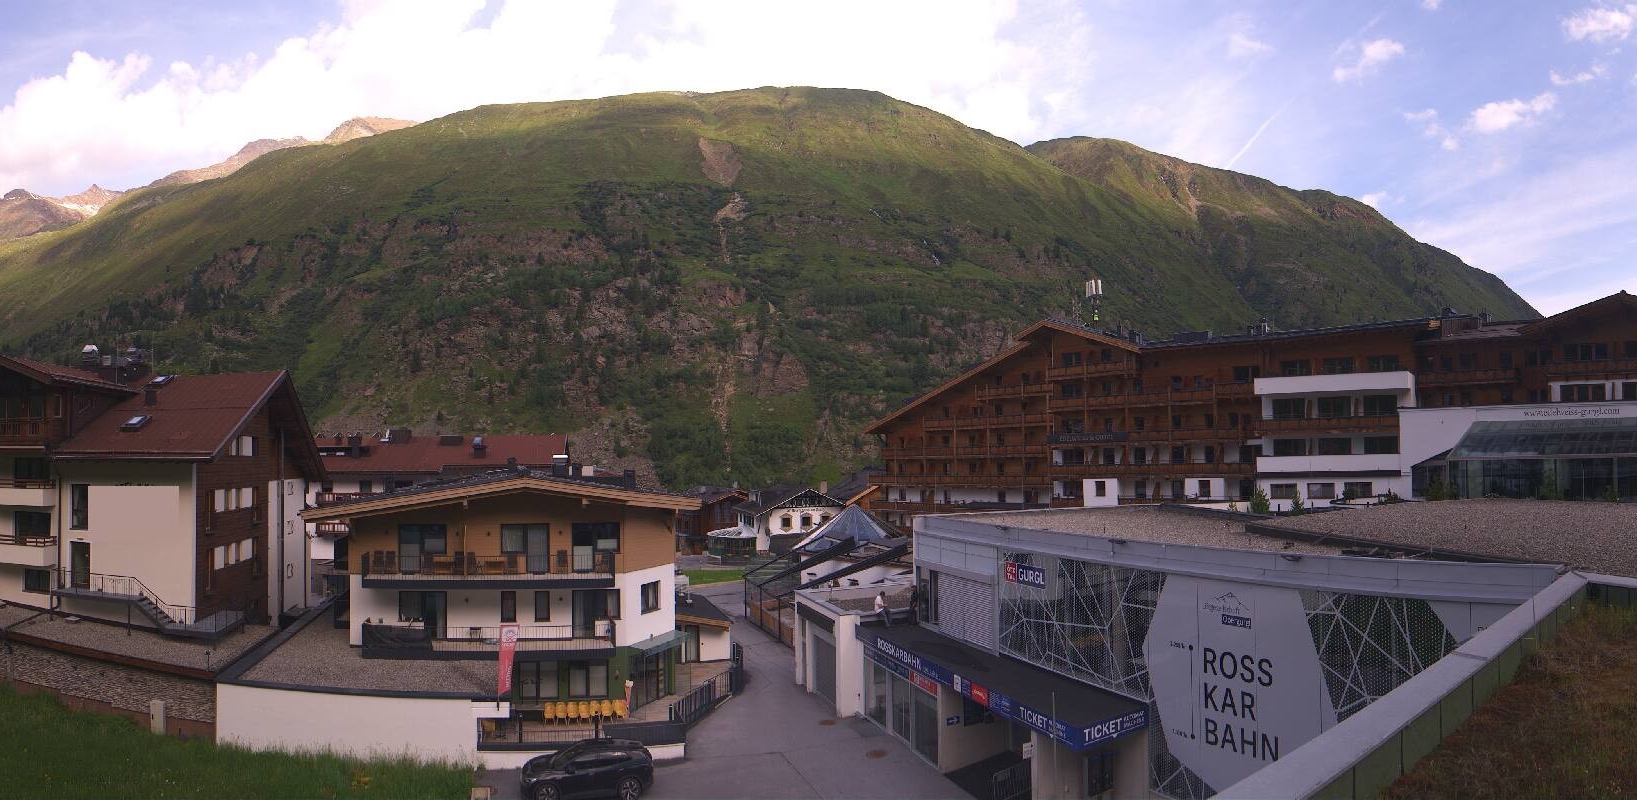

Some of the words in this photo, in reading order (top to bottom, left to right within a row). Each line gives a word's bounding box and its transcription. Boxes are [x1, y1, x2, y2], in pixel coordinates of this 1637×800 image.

[1018, 568, 1045, 585] GURGL
[877, 637, 922, 670] ROSSKARBAHN
[1203, 647, 1273, 687] ROSS
[1019, 706, 1048, 730] TICKET
[1204, 682, 1257, 721] KAR
[1083, 717, 1123, 742] TICKET
[1205, 717, 1279, 762] BAHN
